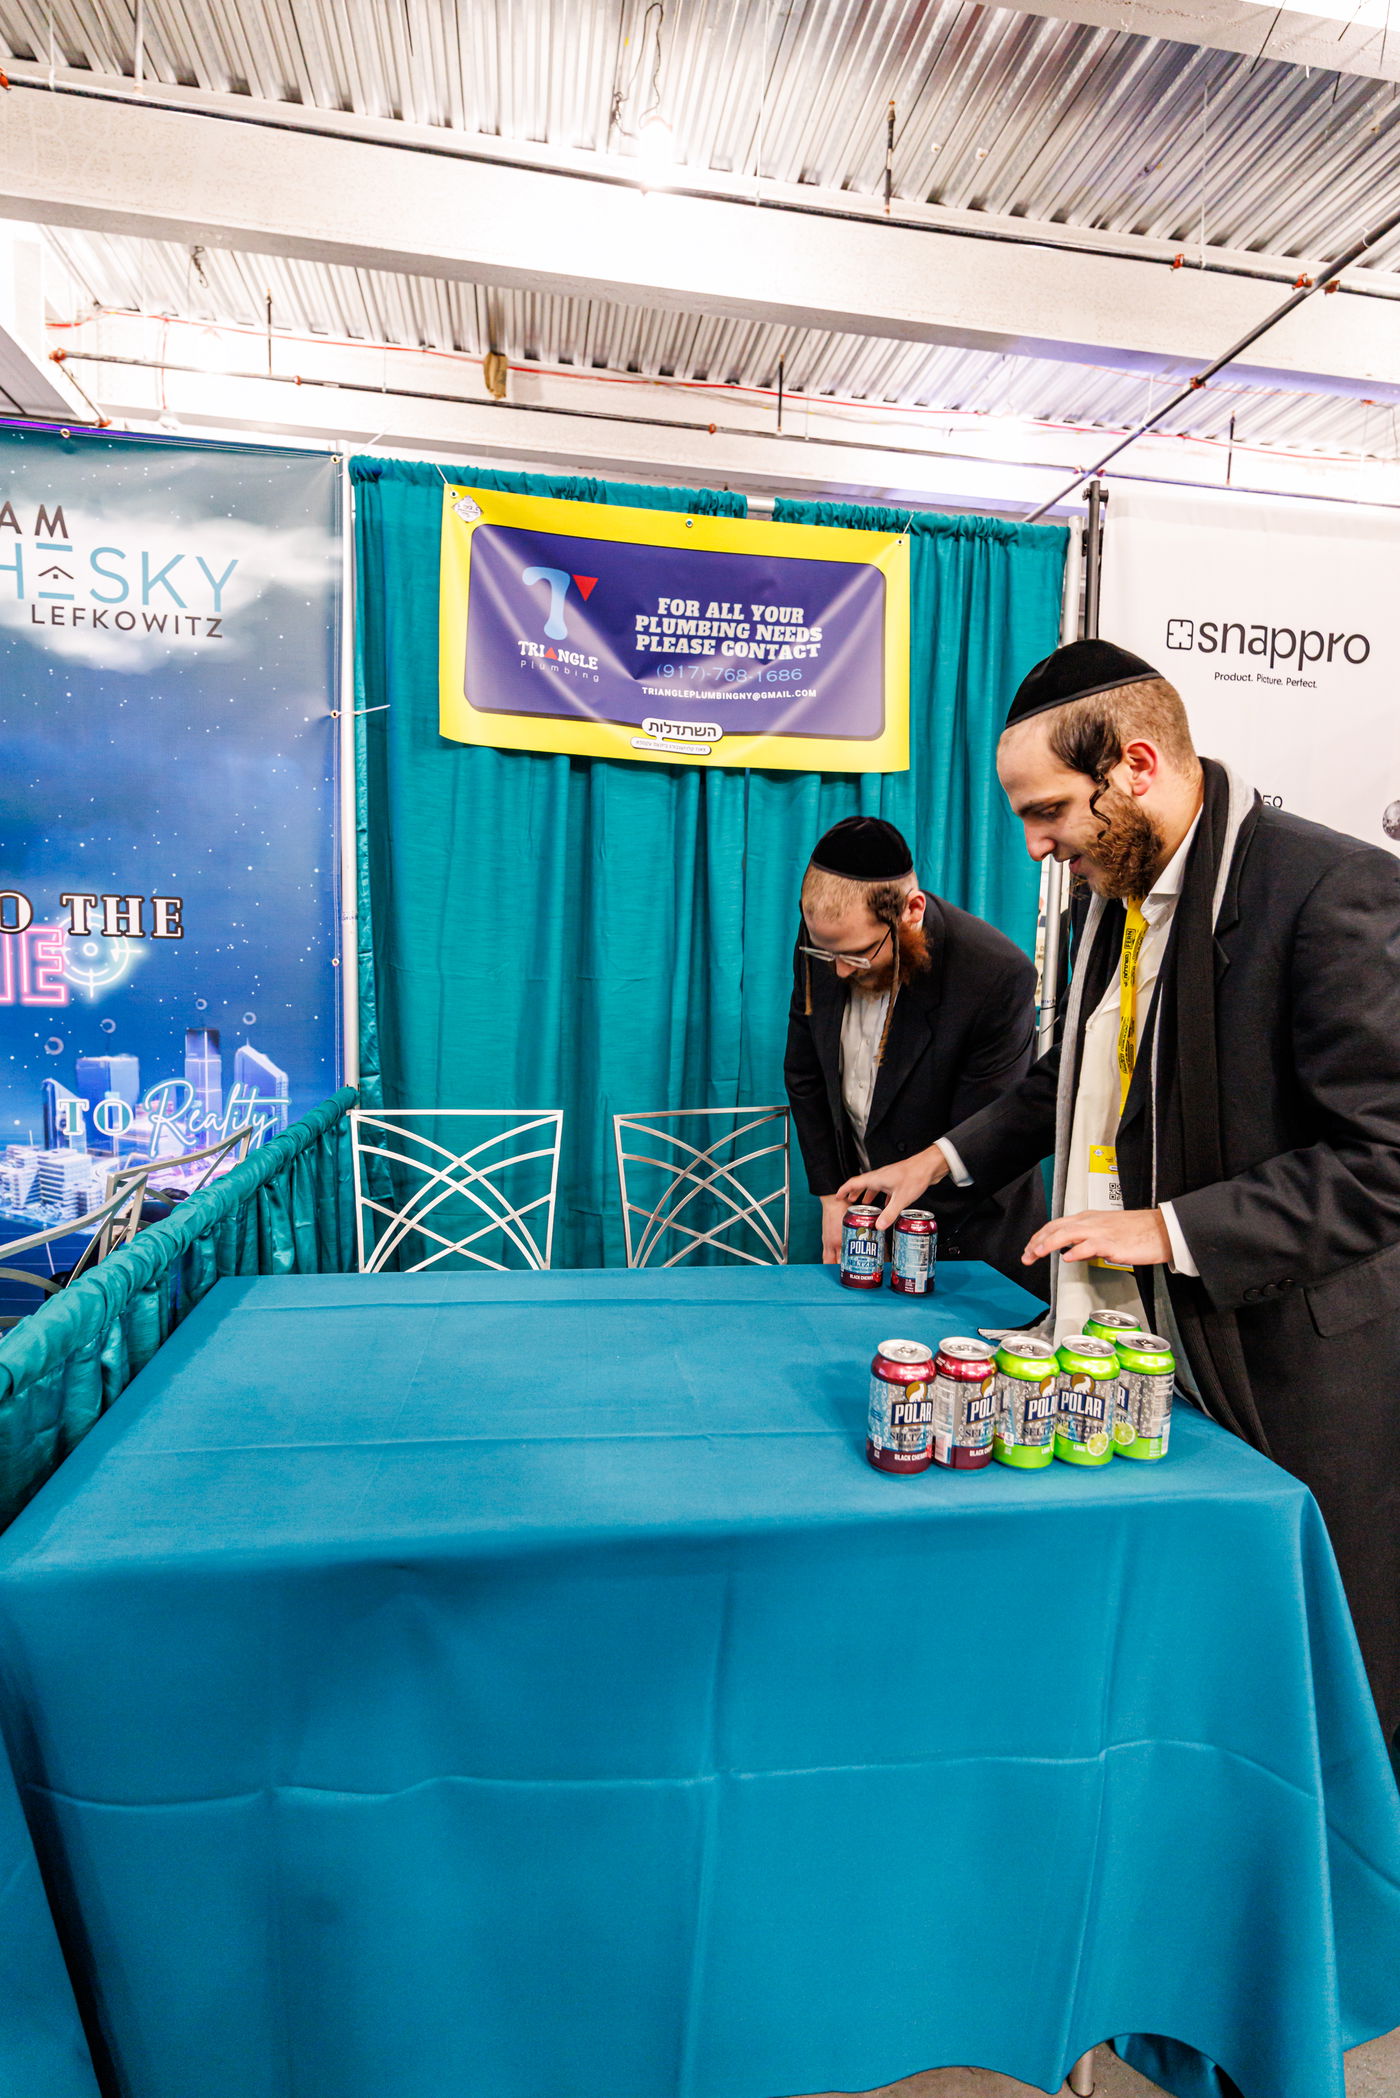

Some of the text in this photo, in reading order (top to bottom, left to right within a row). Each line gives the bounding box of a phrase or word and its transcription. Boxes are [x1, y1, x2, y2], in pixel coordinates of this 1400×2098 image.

[31, 604, 224, 638] LEFKOWITZ
[657, 597, 805, 624] FOR ALL YOUR
[635, 614, 823, 643] PLUMBING NEEDS
[635, 634, 821, 661] PLEASE CONTACT
[1198, 621, 1371, 671] snappro
[520, 659, 600, 683] Plumbing
[656, 663, 803, 683] (917)-768-1686
[1214, 671, 1318, 689] Product. Picture. Perfect.
[642, 686, 817, 701] TRIANGLEPLUMBINGNY@GMAIL.COM
[648, 721, 717, 737] השתדלות
[60, 892, 184, 939] THE
[57, 1078, 292, 1157] TO Reality
[850, 1241, 877, 1256] POLAR
[894, 1402, 932, 1424] POLAR
[1060, 1391, 1102, 1419] POLAR
[894, 1453, 911, 1461] BLACK
